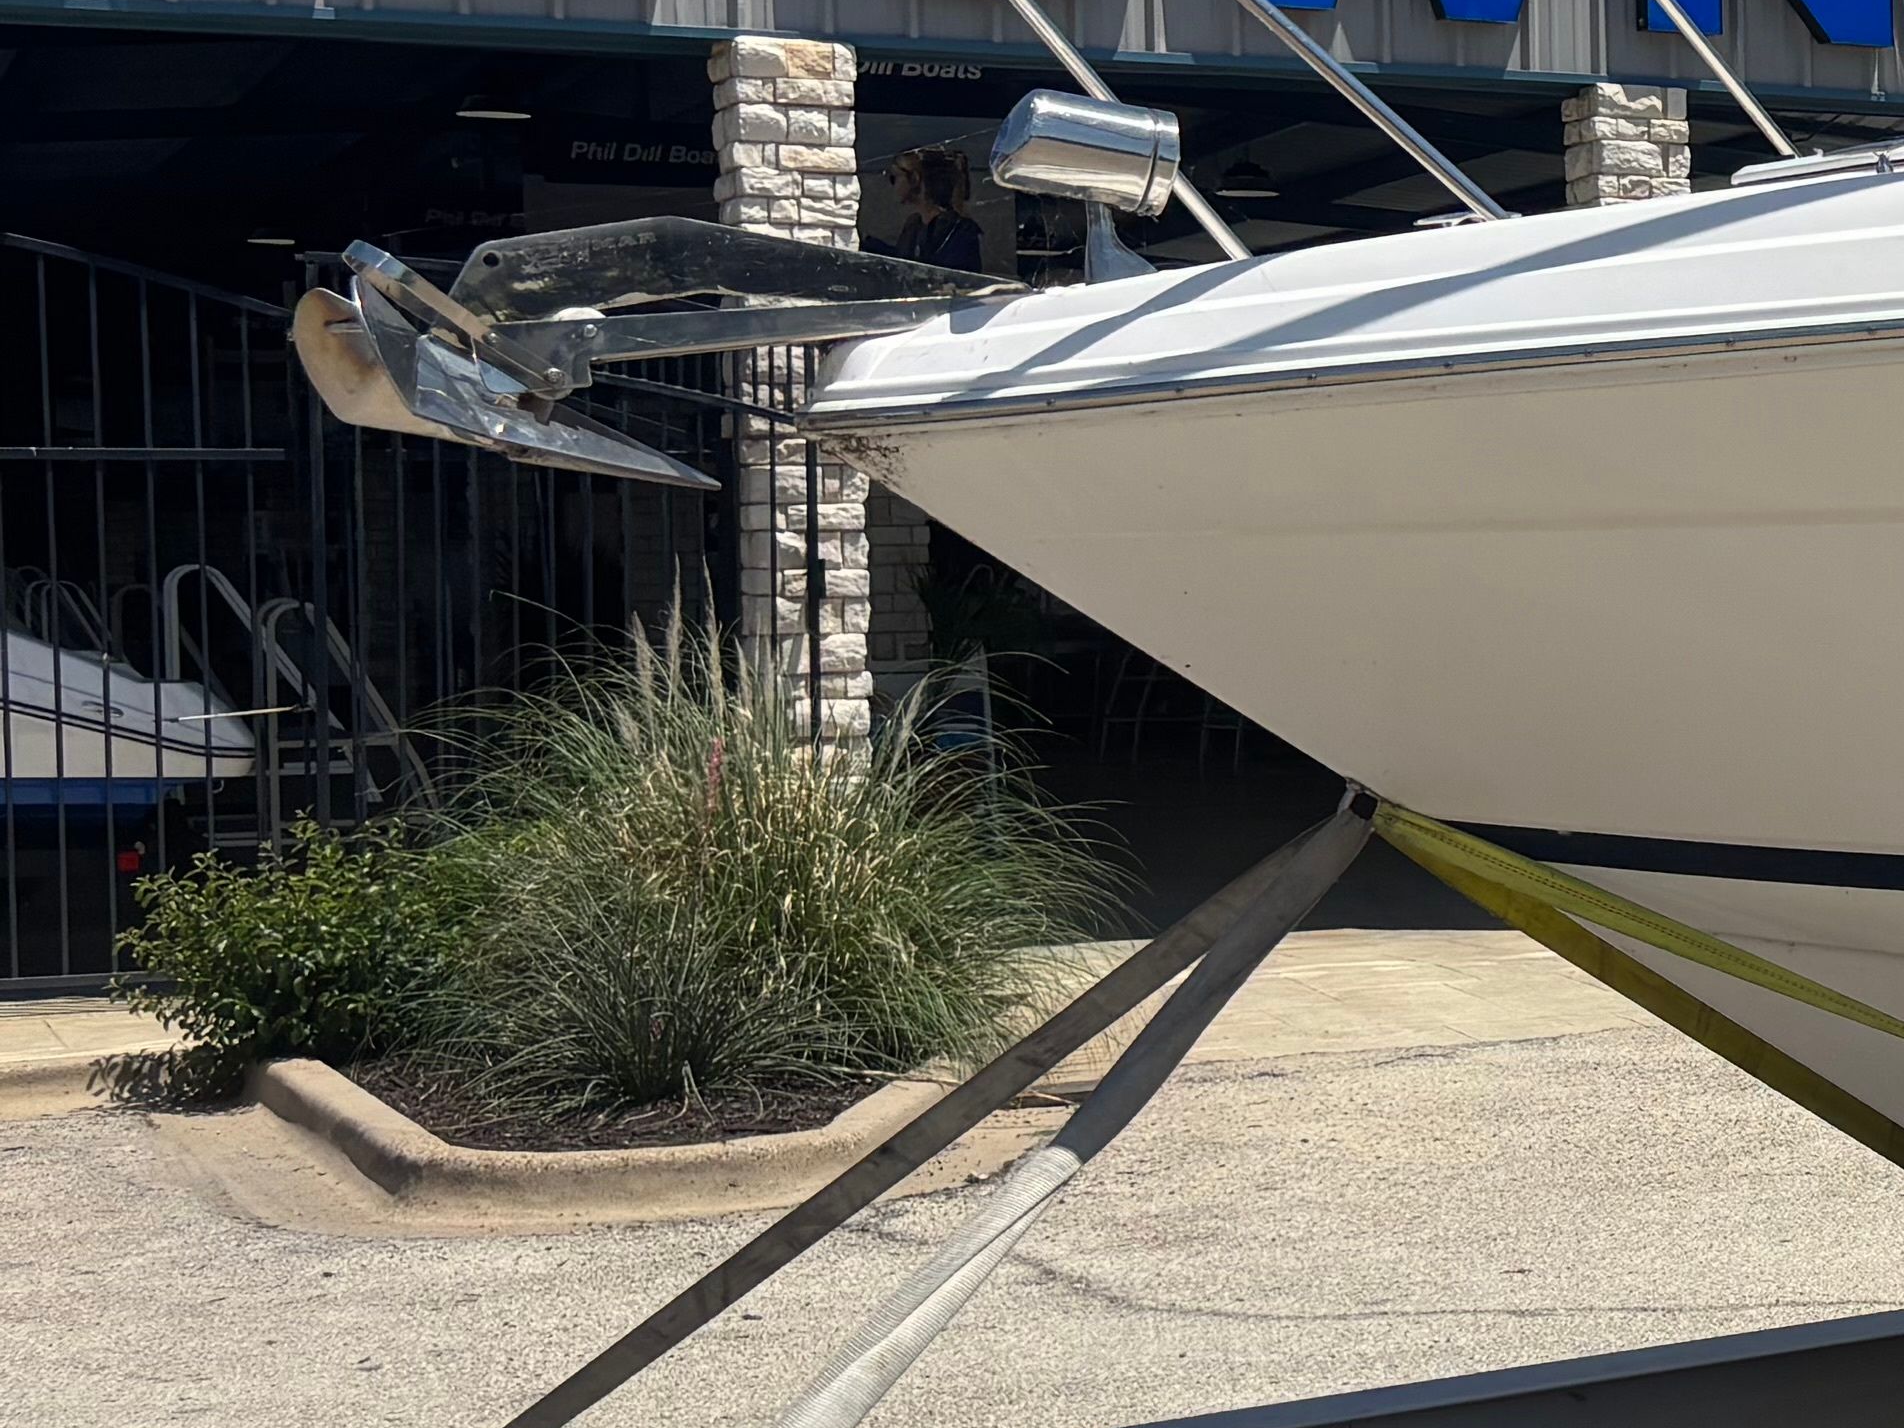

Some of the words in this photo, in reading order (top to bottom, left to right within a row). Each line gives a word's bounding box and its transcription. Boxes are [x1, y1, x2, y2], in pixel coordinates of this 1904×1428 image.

[570, 140, 617, 162] Phil
[623, 141, 663, 162] Dill
[669, 144, 715, 165] Boa
